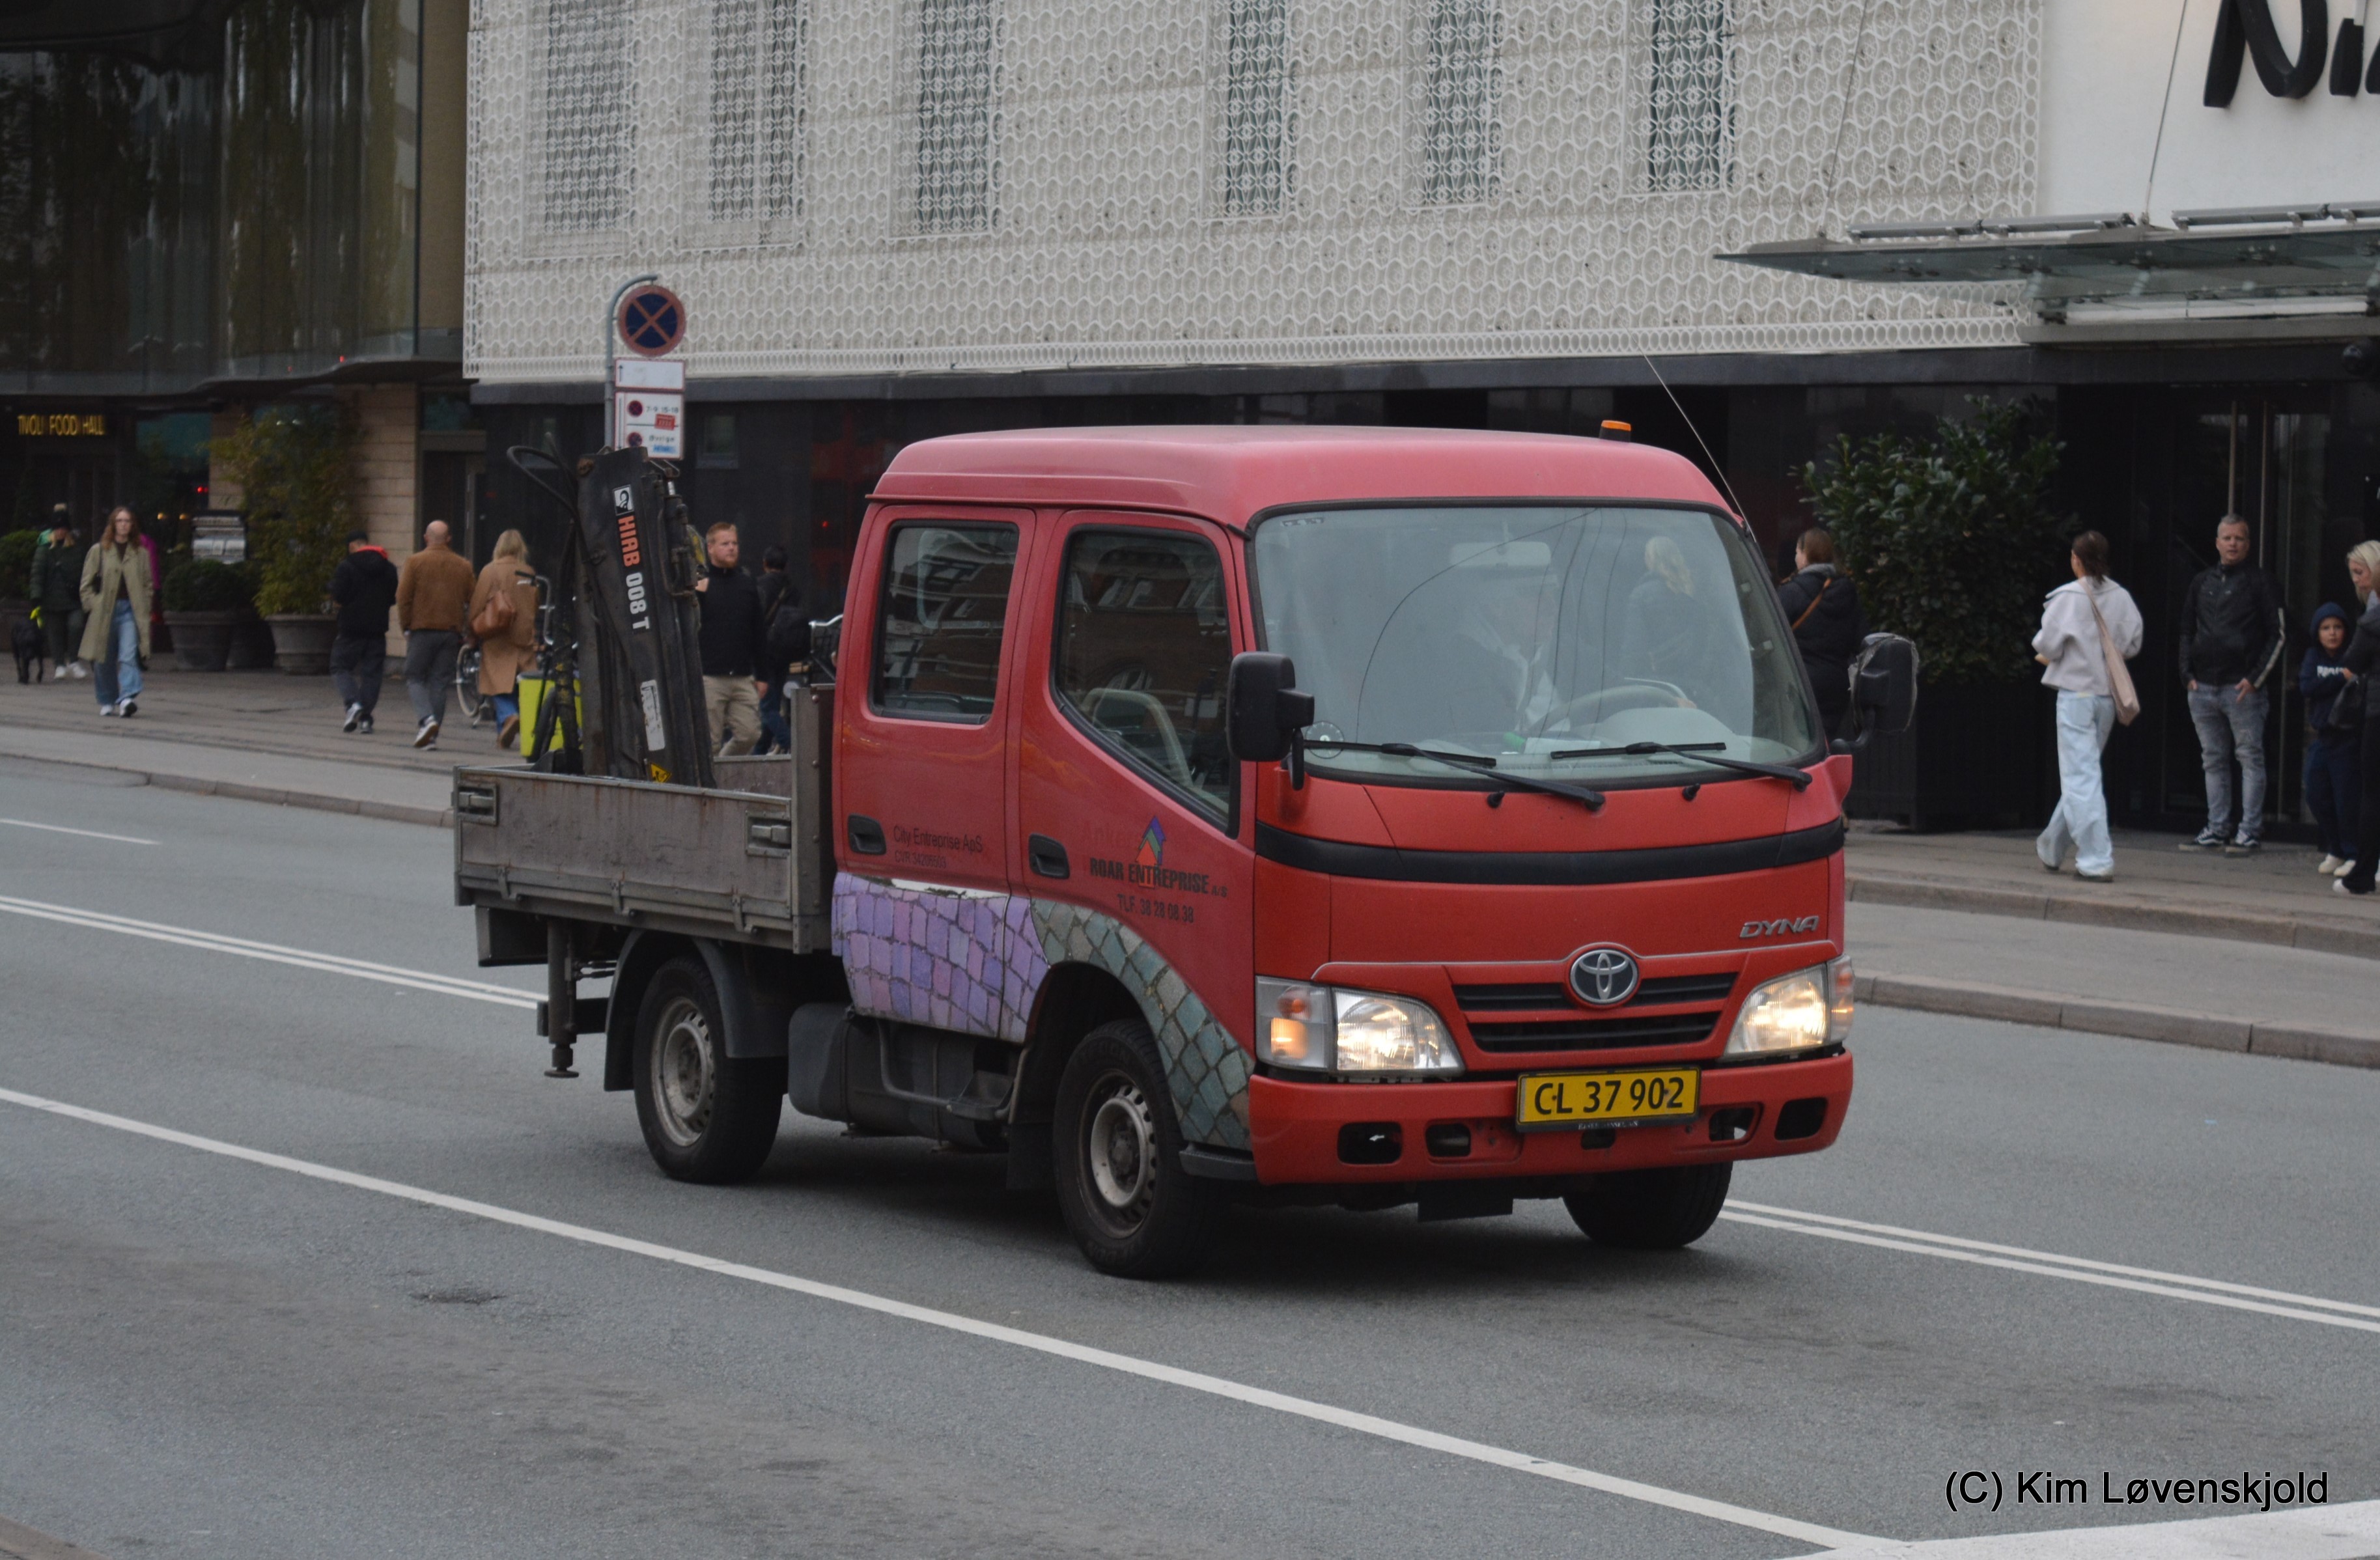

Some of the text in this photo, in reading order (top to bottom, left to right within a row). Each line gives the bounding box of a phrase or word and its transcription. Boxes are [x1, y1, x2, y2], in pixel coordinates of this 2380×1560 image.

[18, 414, 105, 436] TIVOLI FOOD HALL
[618, 515, 650, 630] HIAB 008 T
[893, 825, 983, 856] City Entreprise ApS
[1090, 857, 1227, 898] ROAR ENTREPRISE A/S
[1140, 897, 1151, 916] 38
[1154, 900, 1165, 919] 28
[1168, 902, 1179, 921] 08
[1182, 904, 1194, 924] 38
[1740, 915, 1819, 938] DYNA
[1534, 1076, 1685, 1115] CL 37 902
